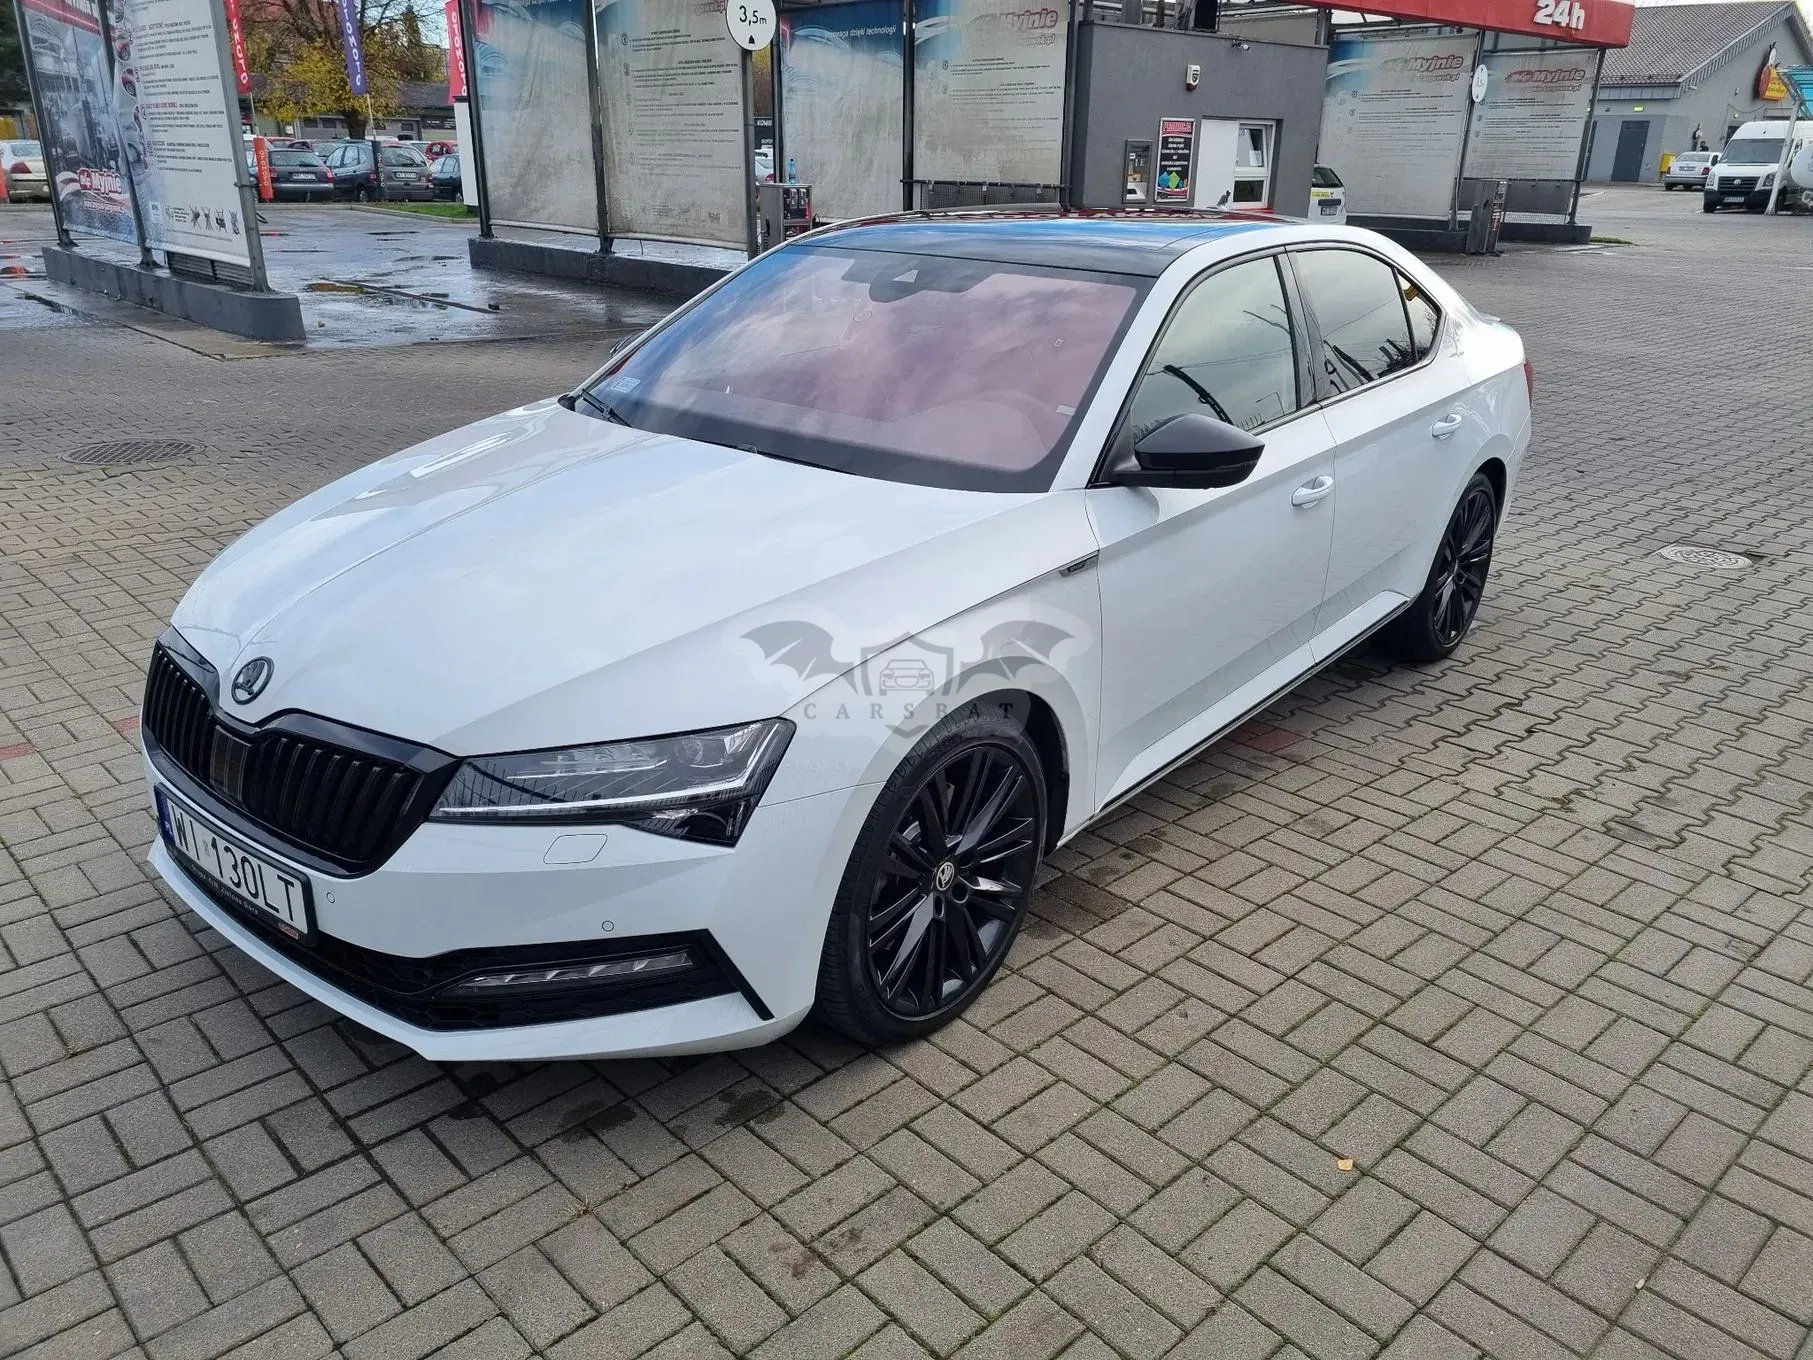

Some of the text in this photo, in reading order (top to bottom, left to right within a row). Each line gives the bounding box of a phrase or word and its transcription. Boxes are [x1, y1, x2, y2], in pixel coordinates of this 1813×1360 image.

[1533, 0, 1585, 30] 24h
[451, 11, 467, 96] OTOMOTO
[1407, 55, 1464, 73] Myjnie
[1532, 68, 1586, 83] Myjnie
[171, 804, 296, 923] WI 130LT
